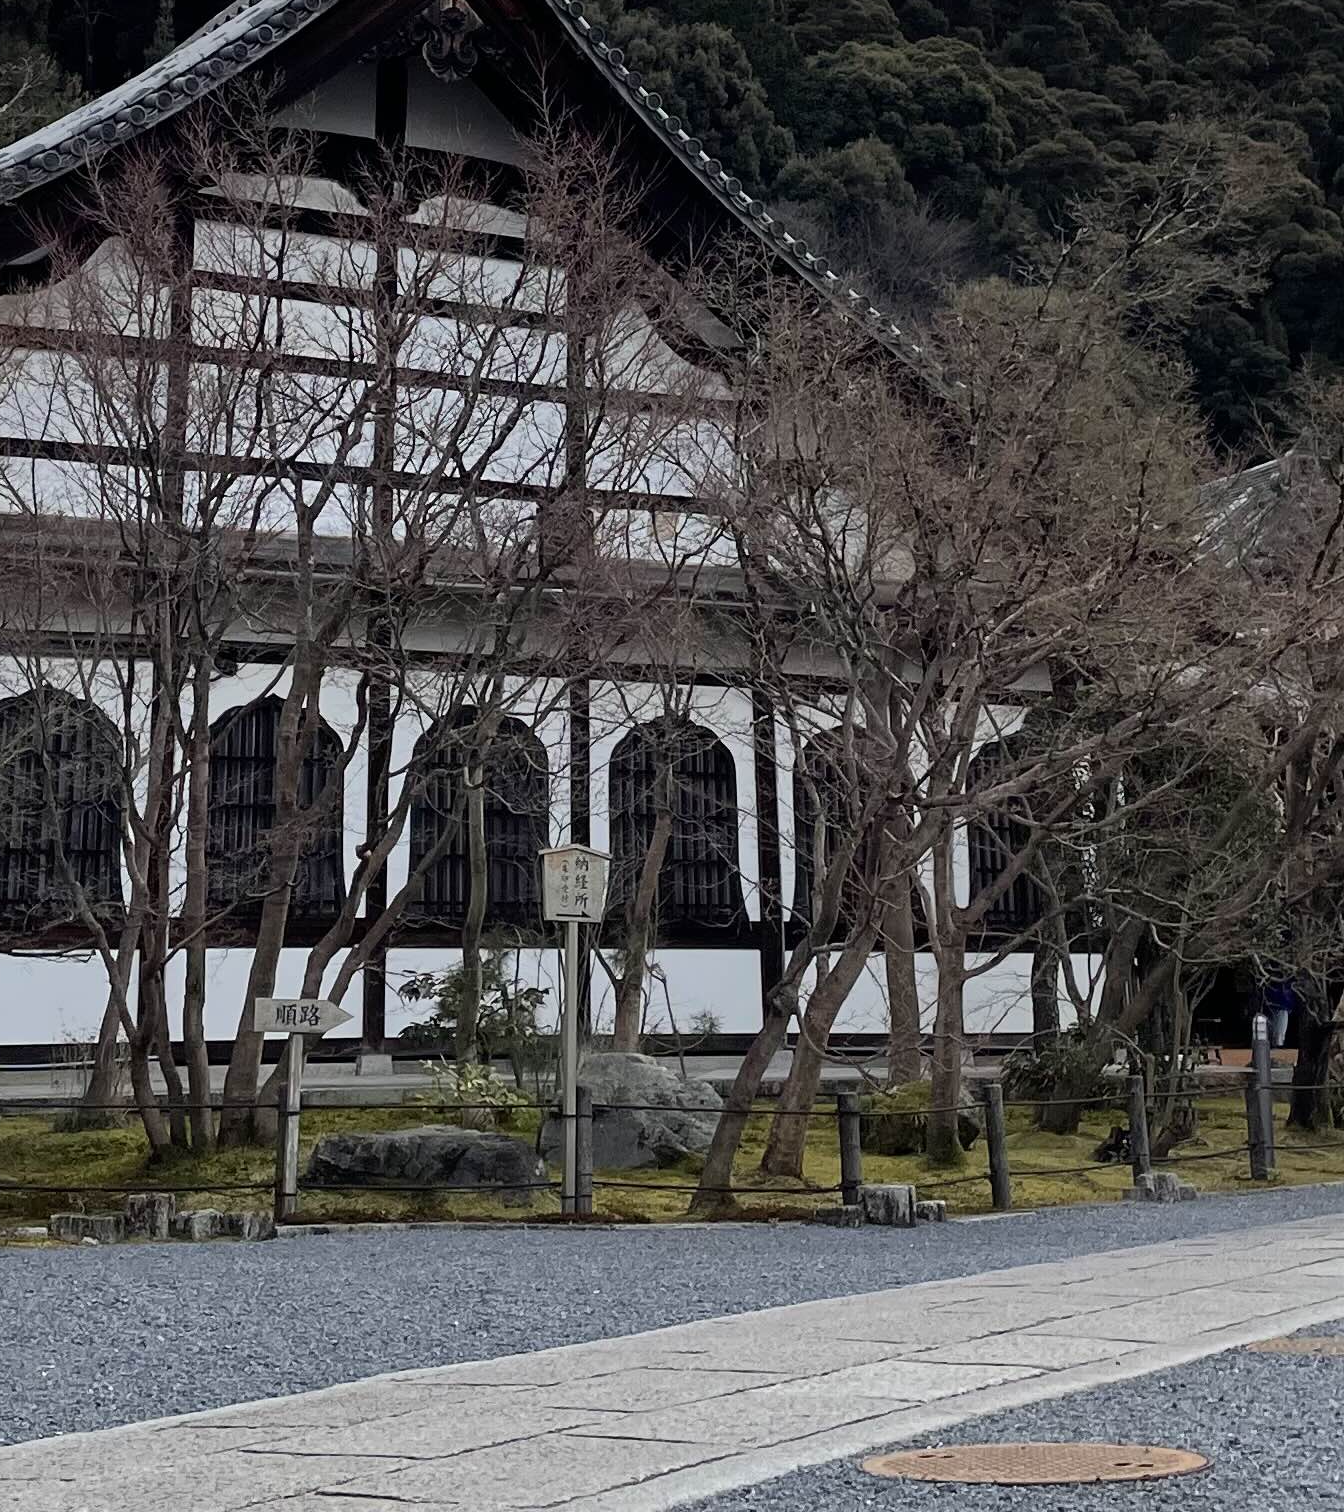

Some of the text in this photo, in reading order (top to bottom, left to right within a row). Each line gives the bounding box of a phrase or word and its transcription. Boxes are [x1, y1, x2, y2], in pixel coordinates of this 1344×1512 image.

[575, 856, 588, 909] 納経所
[275, 1004, 320, 1026] 順路
